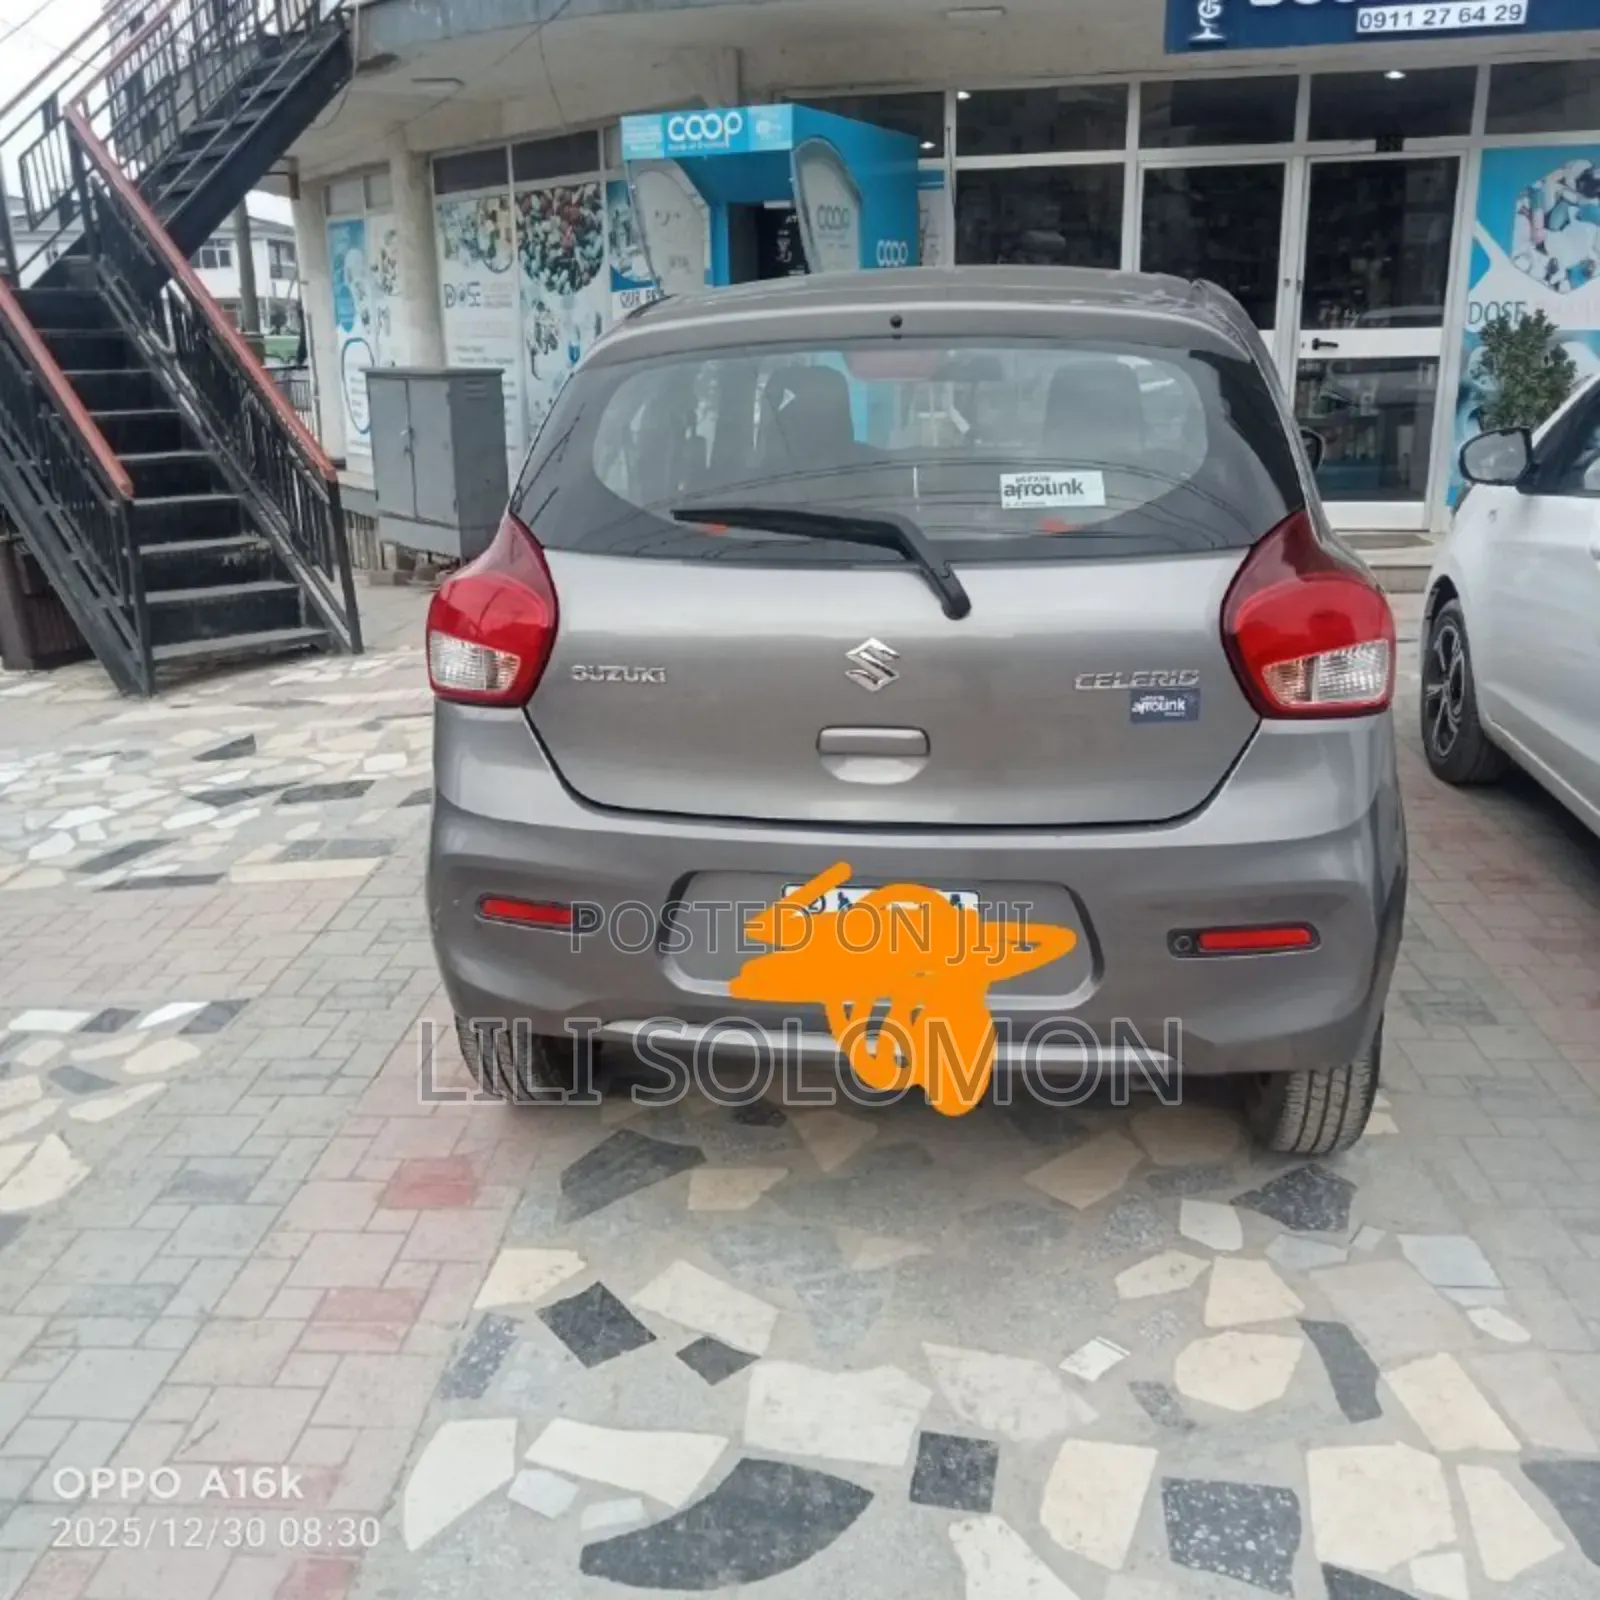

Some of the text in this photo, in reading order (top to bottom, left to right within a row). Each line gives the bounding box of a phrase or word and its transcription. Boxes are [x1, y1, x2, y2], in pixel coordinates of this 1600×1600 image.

[1359, 3, 1523, 30] 0911 27 64 29
[667, 110, 743, 149] coop
[571, 664, 667, 684] SUZUKI
[1072, 669, 1200, 690] CELERIO
